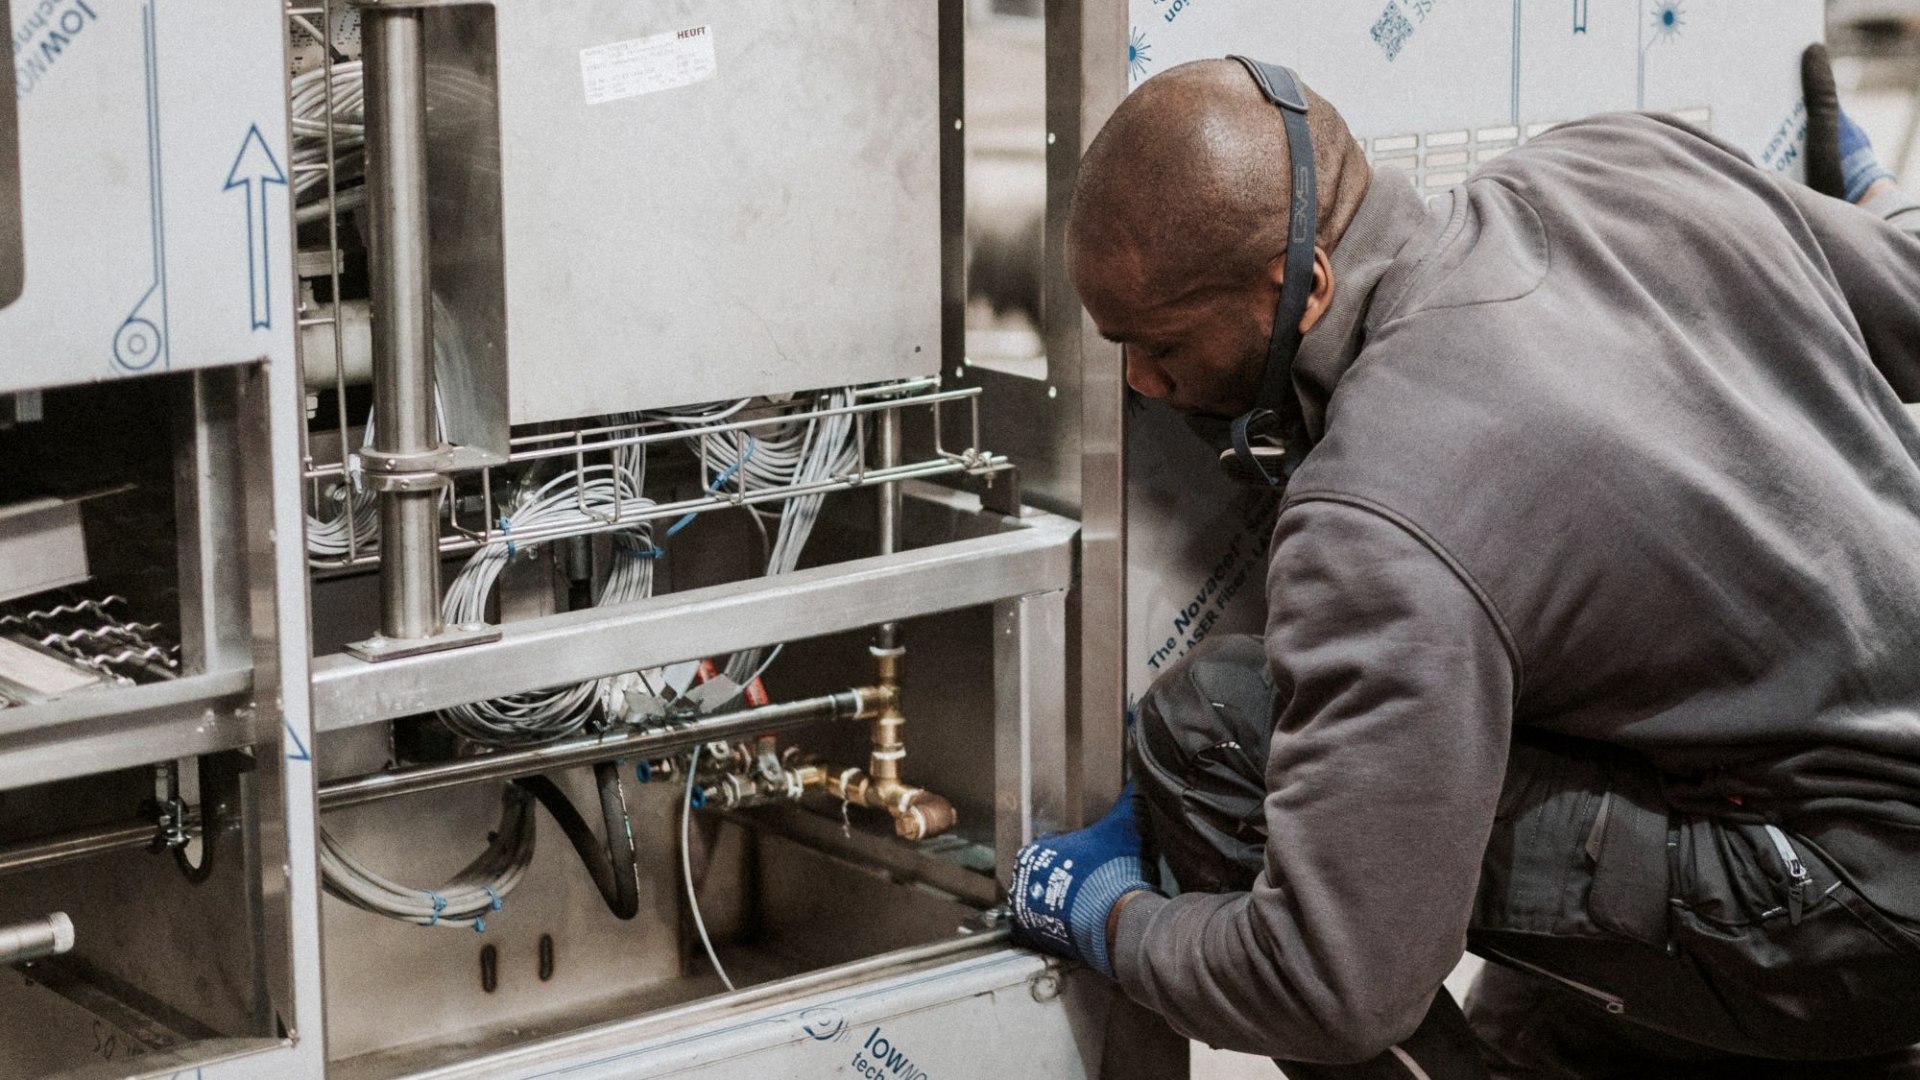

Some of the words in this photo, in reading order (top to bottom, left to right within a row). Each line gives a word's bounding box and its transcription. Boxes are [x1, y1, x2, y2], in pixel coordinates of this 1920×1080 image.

[677, 26, 706, 40] HEUFT
[1179, 609, 1220, 657] ASER
[1147, 636, 1178, 670] The
